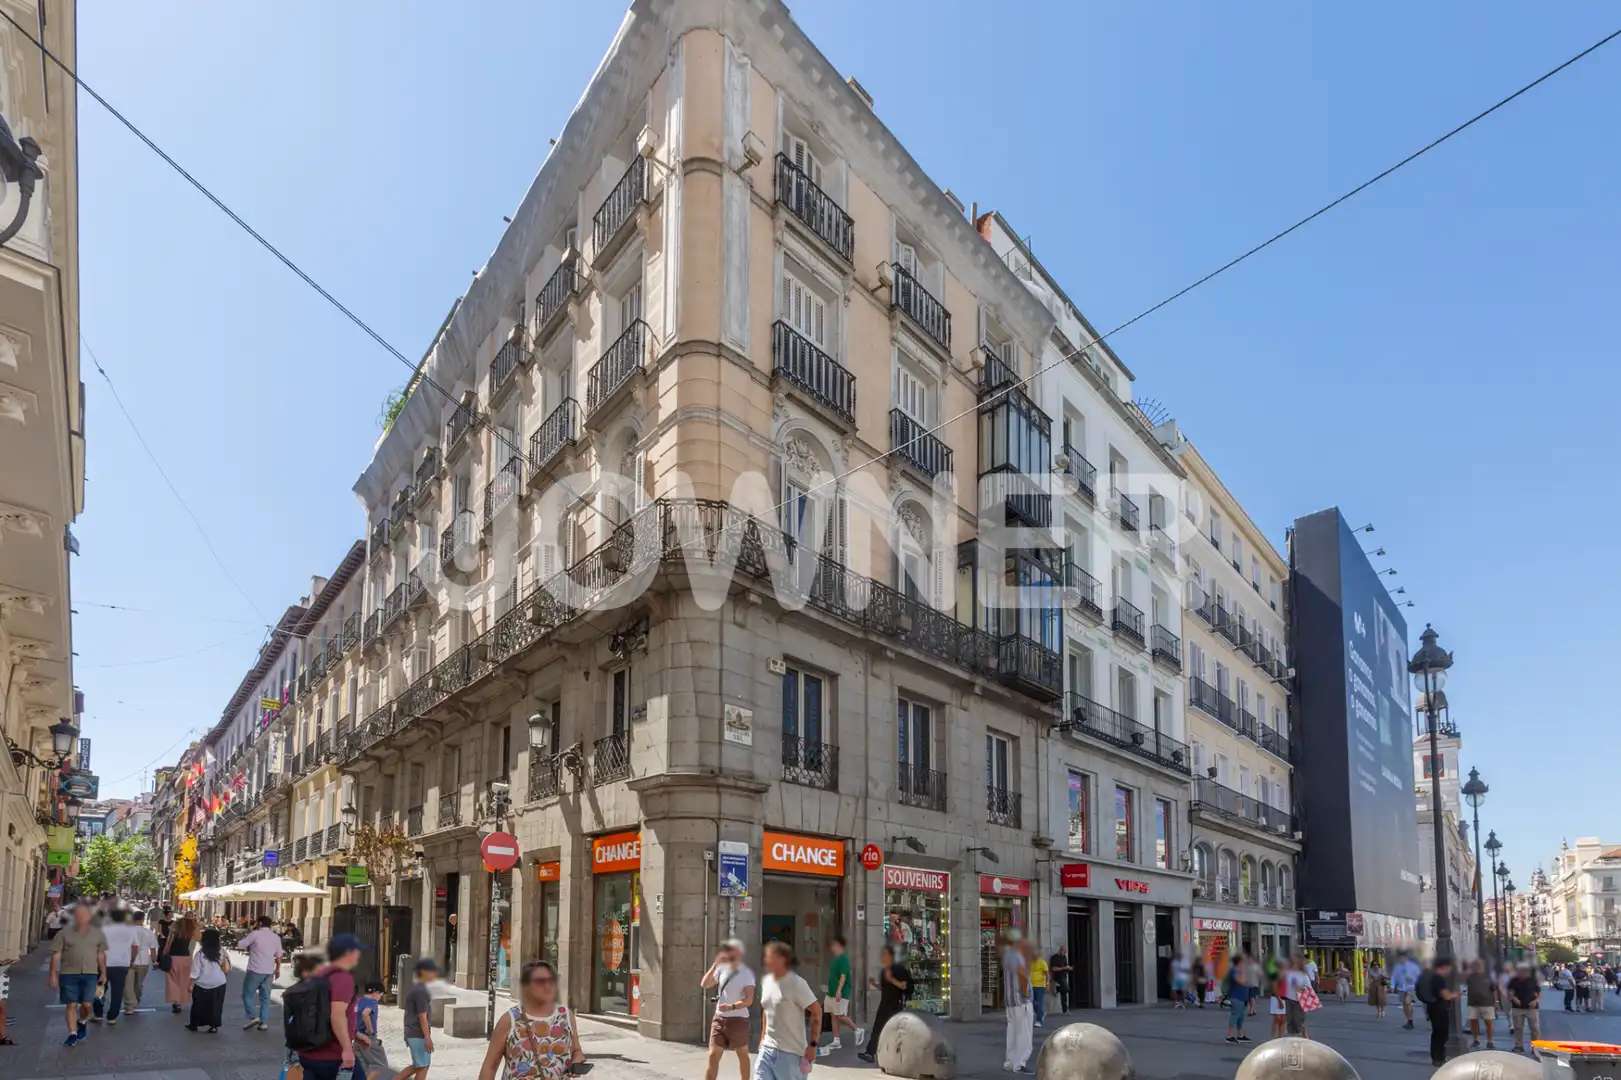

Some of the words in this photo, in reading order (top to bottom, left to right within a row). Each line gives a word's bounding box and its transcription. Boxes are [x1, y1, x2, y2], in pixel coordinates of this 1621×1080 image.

[81, 739, 89, 770] HOSTAL
[596, 842, 641, 863] CHANGE
[771, 842, 837, 867] CHANGE
[863, 848, 878, 862] ria
[887, 869, 943, 890] SOUVENIRS
[1115, 878, 1150, 894] VIPS
